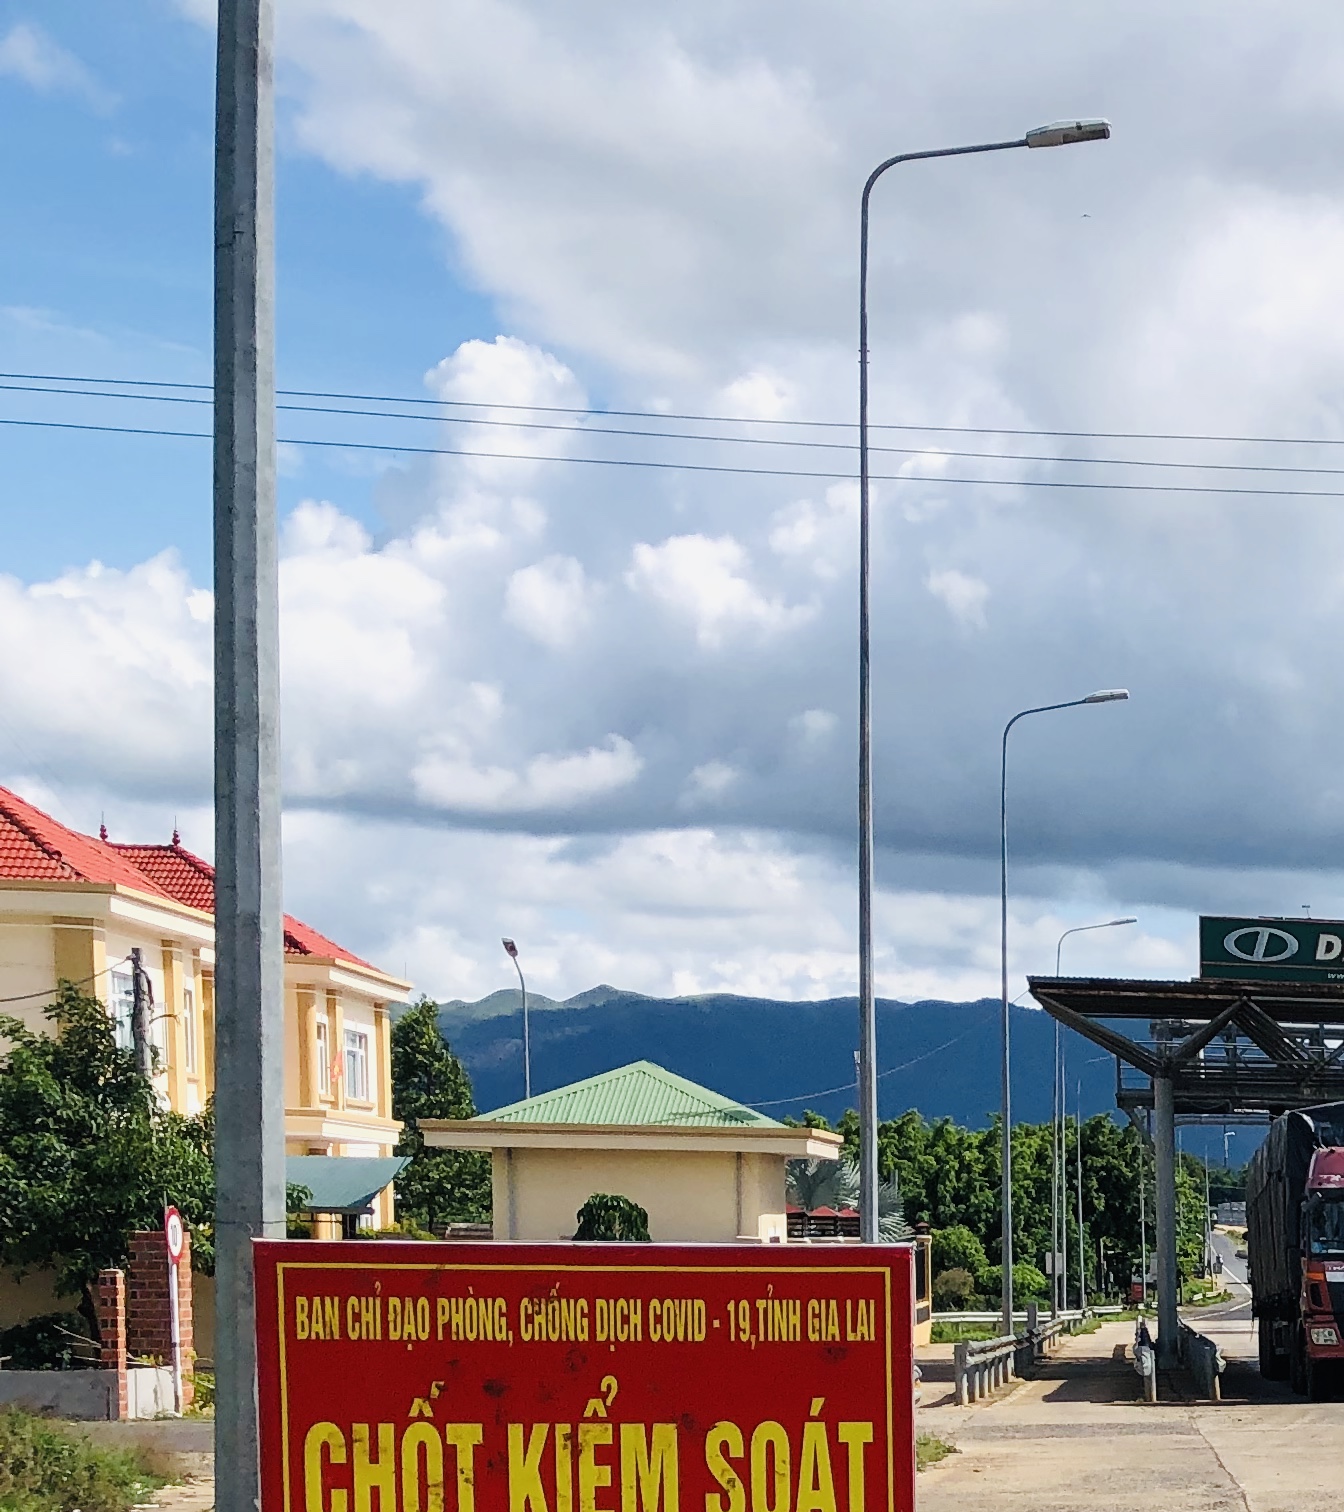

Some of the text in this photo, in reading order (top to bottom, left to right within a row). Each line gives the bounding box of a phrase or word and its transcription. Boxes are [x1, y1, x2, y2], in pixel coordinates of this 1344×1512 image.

[296, 1295, 339, 1340] BAN
[346, 1281, 383, 1341] CHỈ
[388, 1297, 430, 1351] ĐẠO
[437, 1286, 513, 1346] PHÒNG,
[520, 1282, 589, 1342] CHỐNG
[596, 1297, 642, 1352] DỊCH
[648, 1299, 706, 1342] COVID
[807, 1298, 840, 1342] GIA
[846, 1299, 876, 1342] LAI
